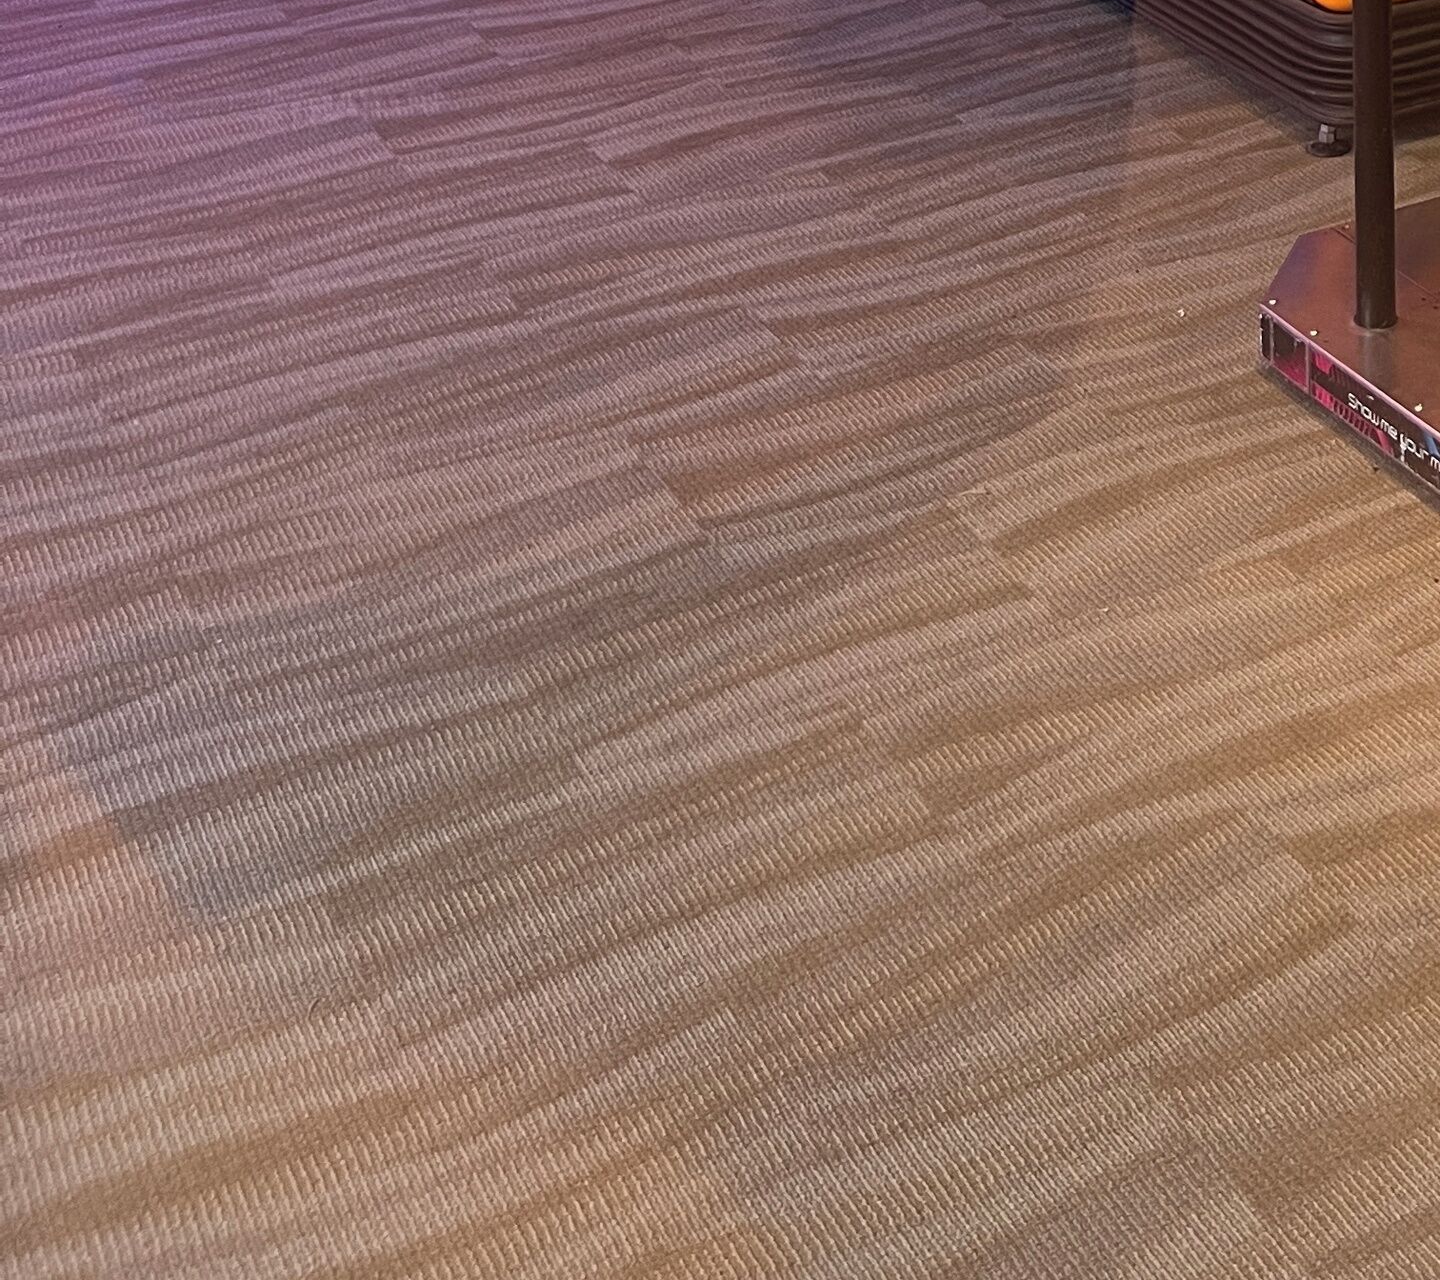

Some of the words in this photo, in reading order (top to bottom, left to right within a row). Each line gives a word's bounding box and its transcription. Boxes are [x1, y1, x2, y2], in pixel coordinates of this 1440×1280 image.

[1348, 393, 1380, 426] Show
[1380, 418, 1398, 441] me
[1399, 433, 1430, 460] your
